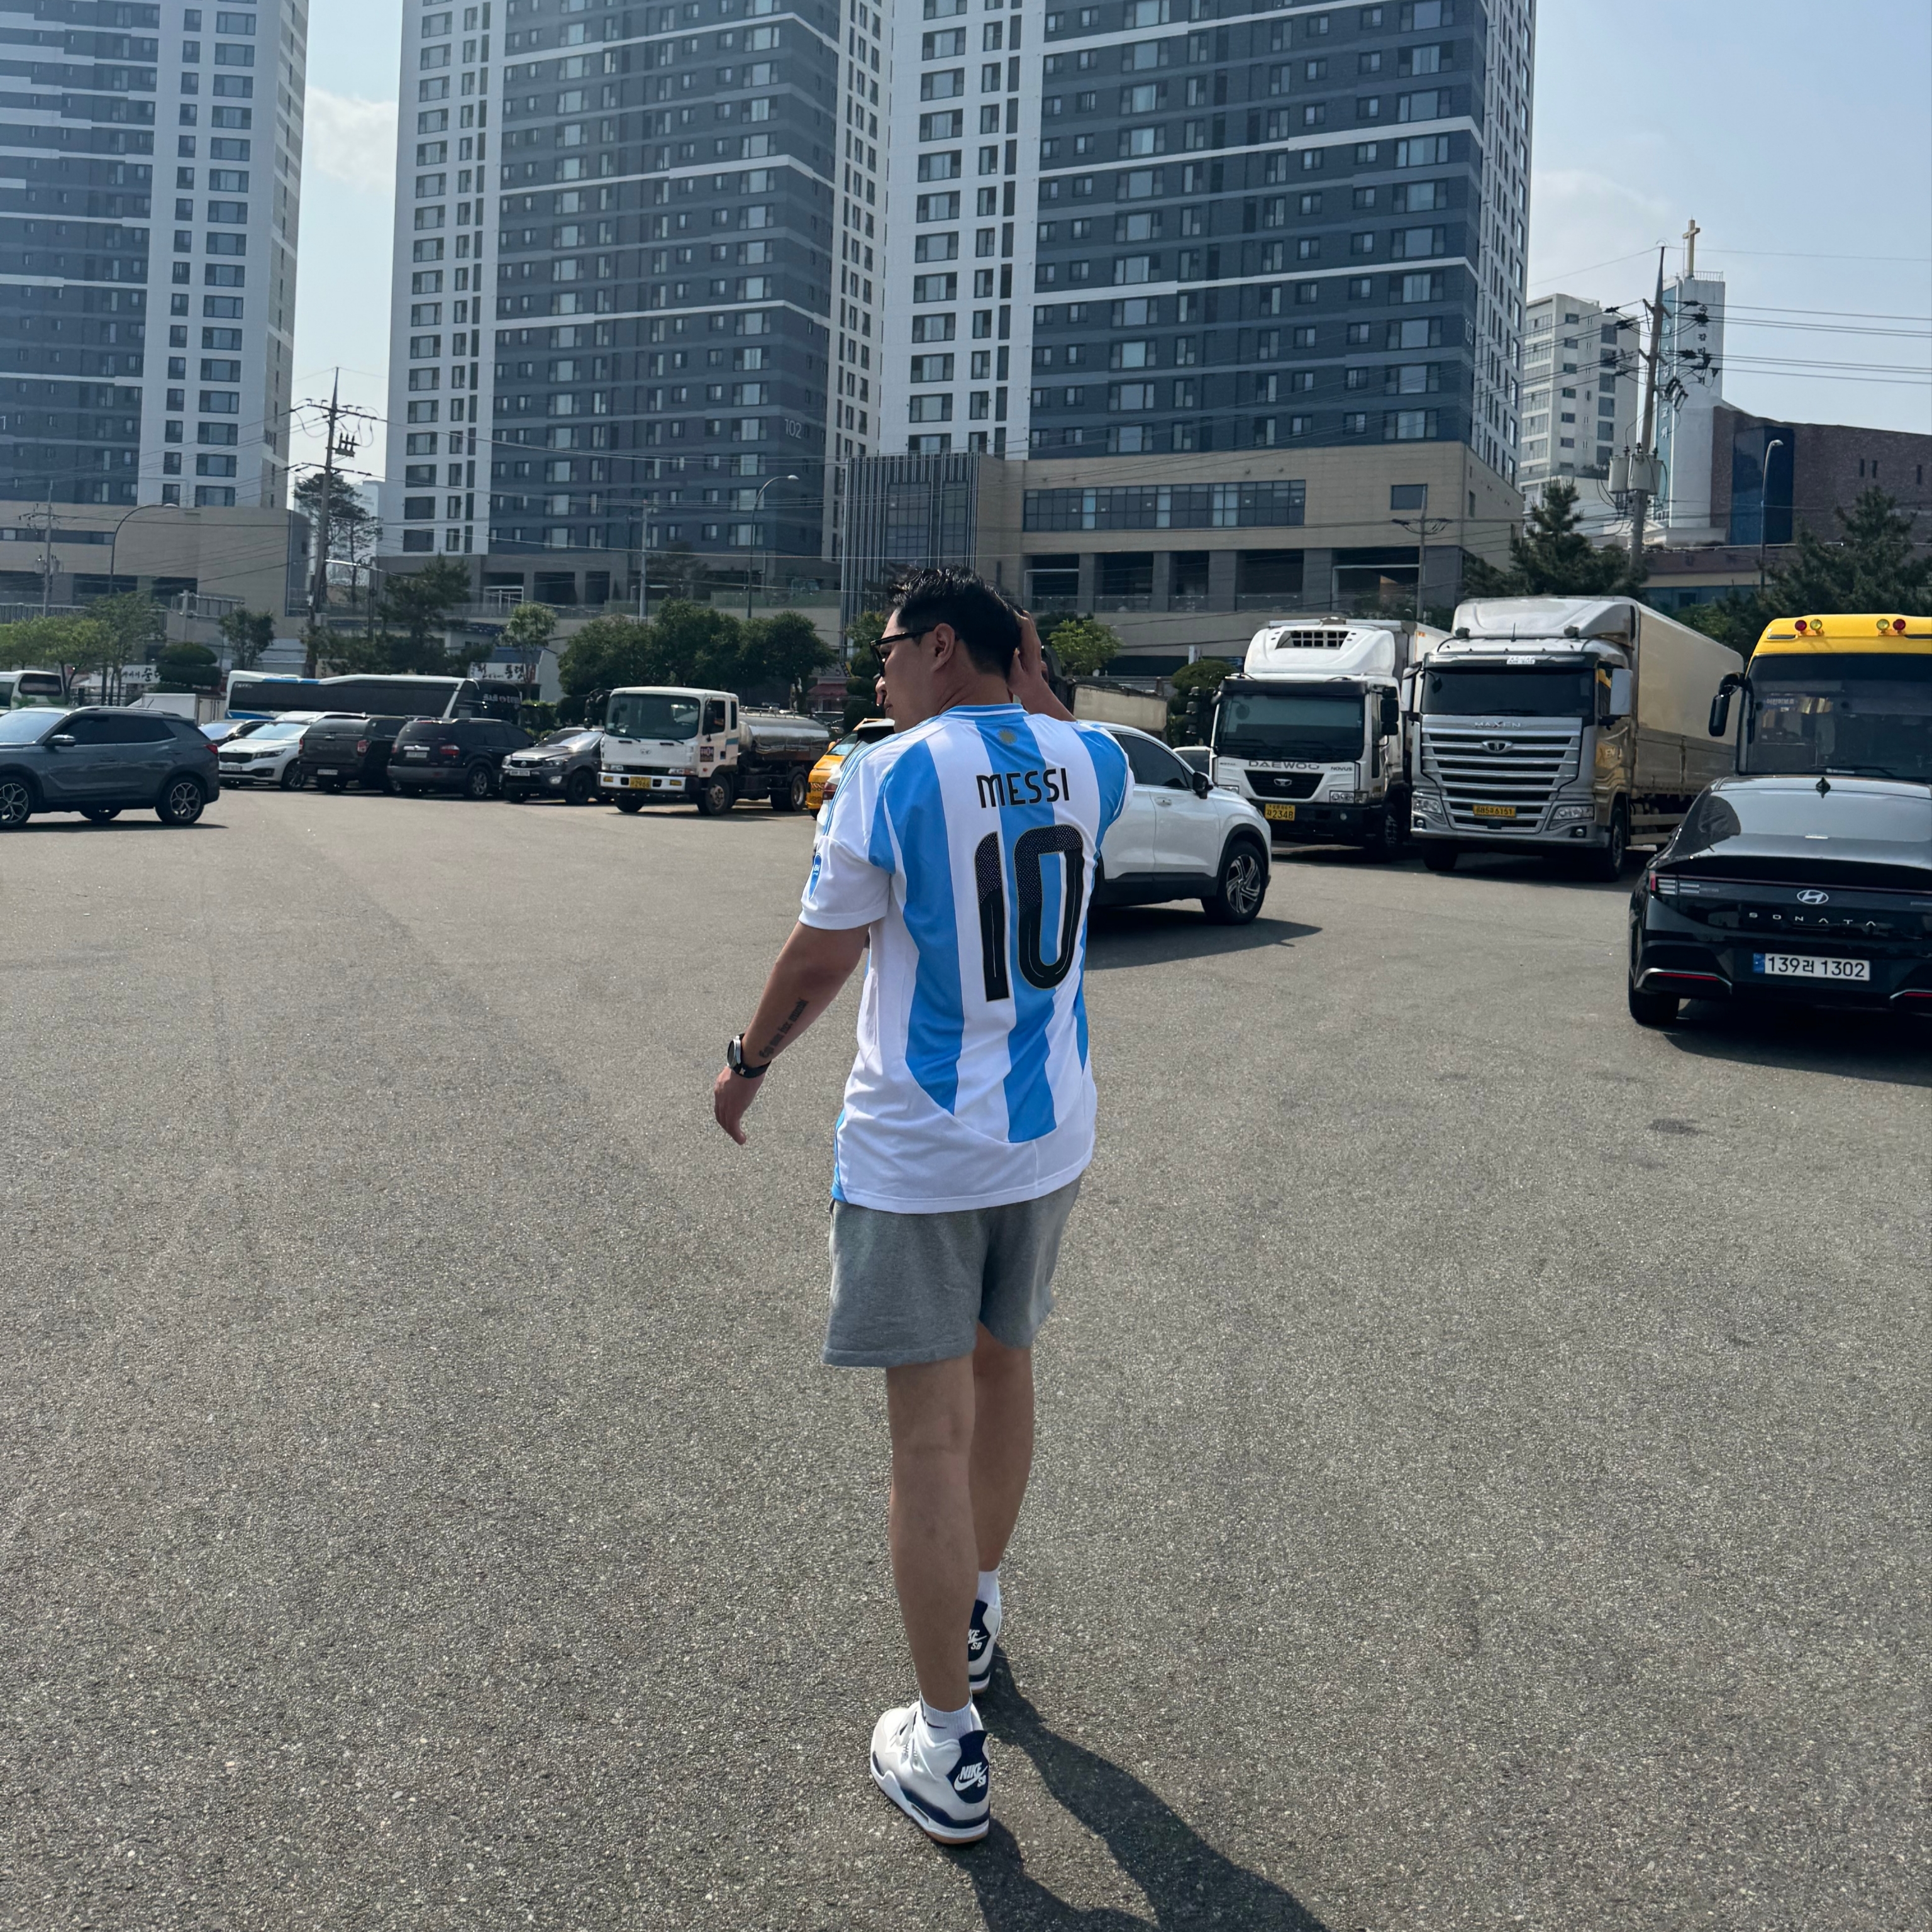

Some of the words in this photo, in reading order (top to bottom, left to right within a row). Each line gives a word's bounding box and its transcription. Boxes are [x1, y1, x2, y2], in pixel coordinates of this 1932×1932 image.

[785, 418, 802, 439] 102
[1248, 760, 1320, 770] DAEWOO
[976, 767, 1070, 809] MESSI
[974, 824, 1085, 1002] 10
[1749, 912, 1877, 926] SONATA
[1821, 960, 1865, 978] 1302
[969, 1629, 980, 1640] KE
[970, 1641, 982, 1650] SB
[959, 1762, 982, 1780] NIKE
